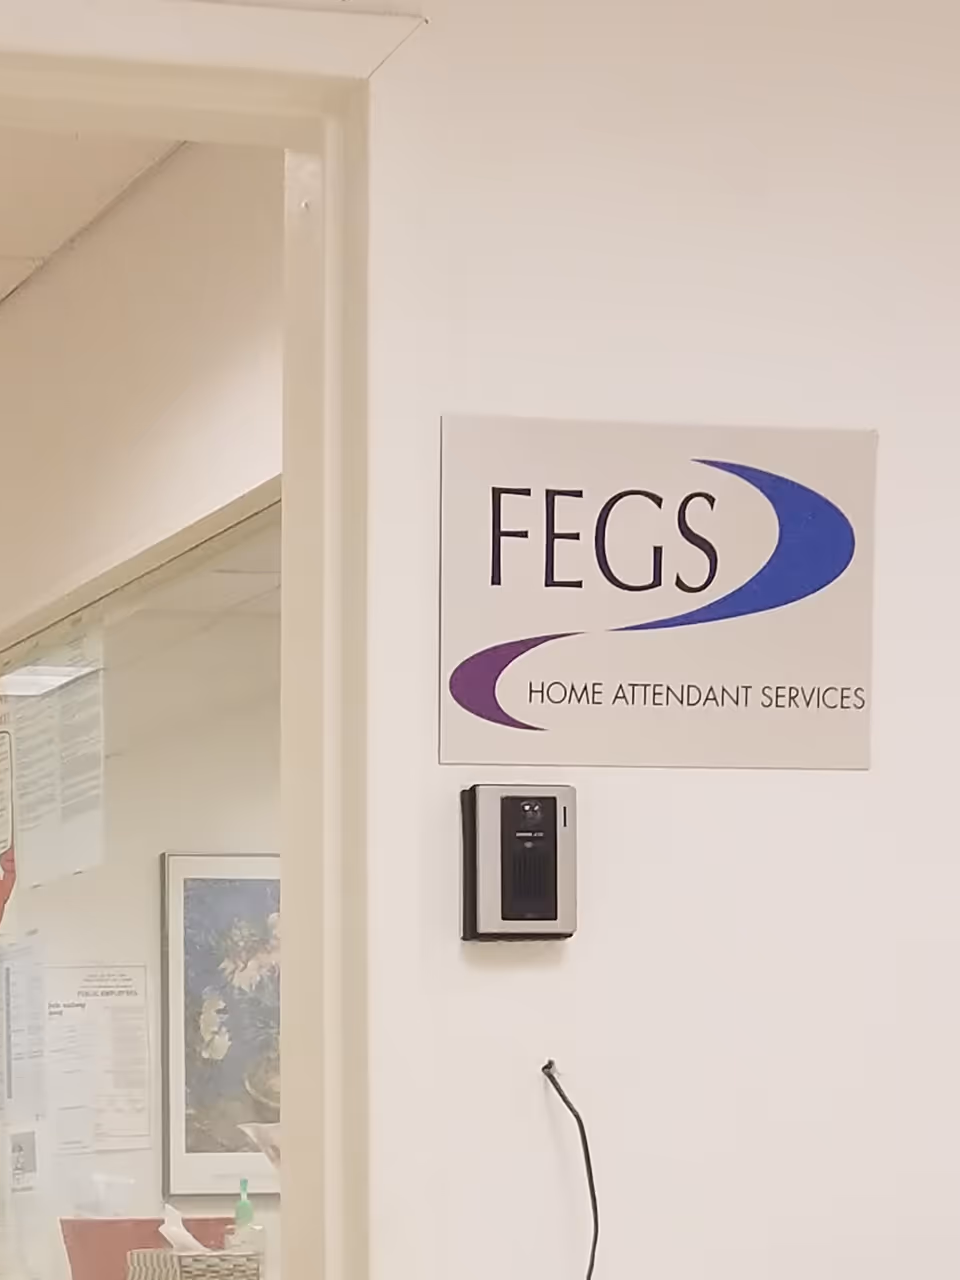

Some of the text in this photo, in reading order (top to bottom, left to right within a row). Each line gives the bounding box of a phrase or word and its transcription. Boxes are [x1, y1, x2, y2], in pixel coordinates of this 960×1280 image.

[490, 486, 719, 594] FEGS
[528, 680, 866, 710] HOME ATTENDANT SERVICES
